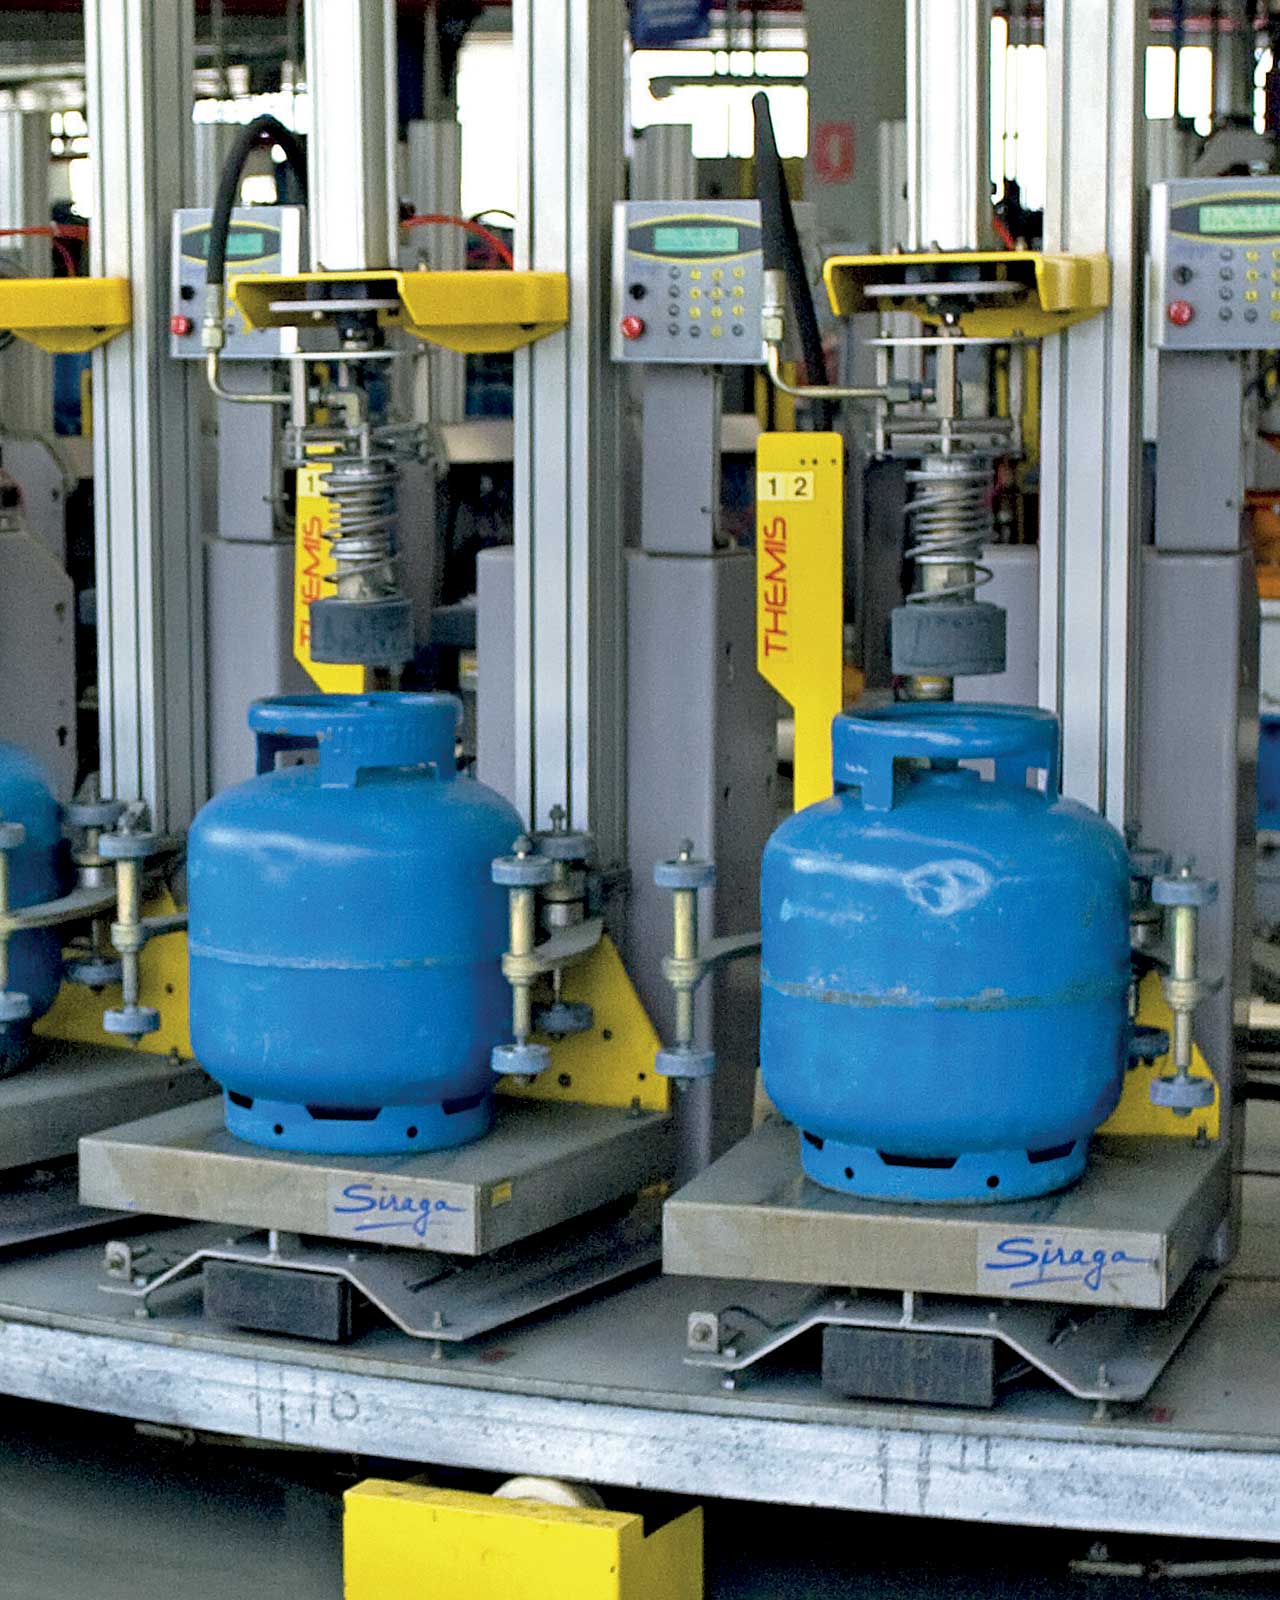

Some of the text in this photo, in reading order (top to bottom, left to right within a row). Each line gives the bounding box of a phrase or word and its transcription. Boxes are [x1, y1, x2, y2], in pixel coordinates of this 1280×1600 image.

[763, 515, 788, 657] THEMIS
[334, 1183, 467, 1237] Siraga
[984, 1236, 1153, 1291] Siraga
